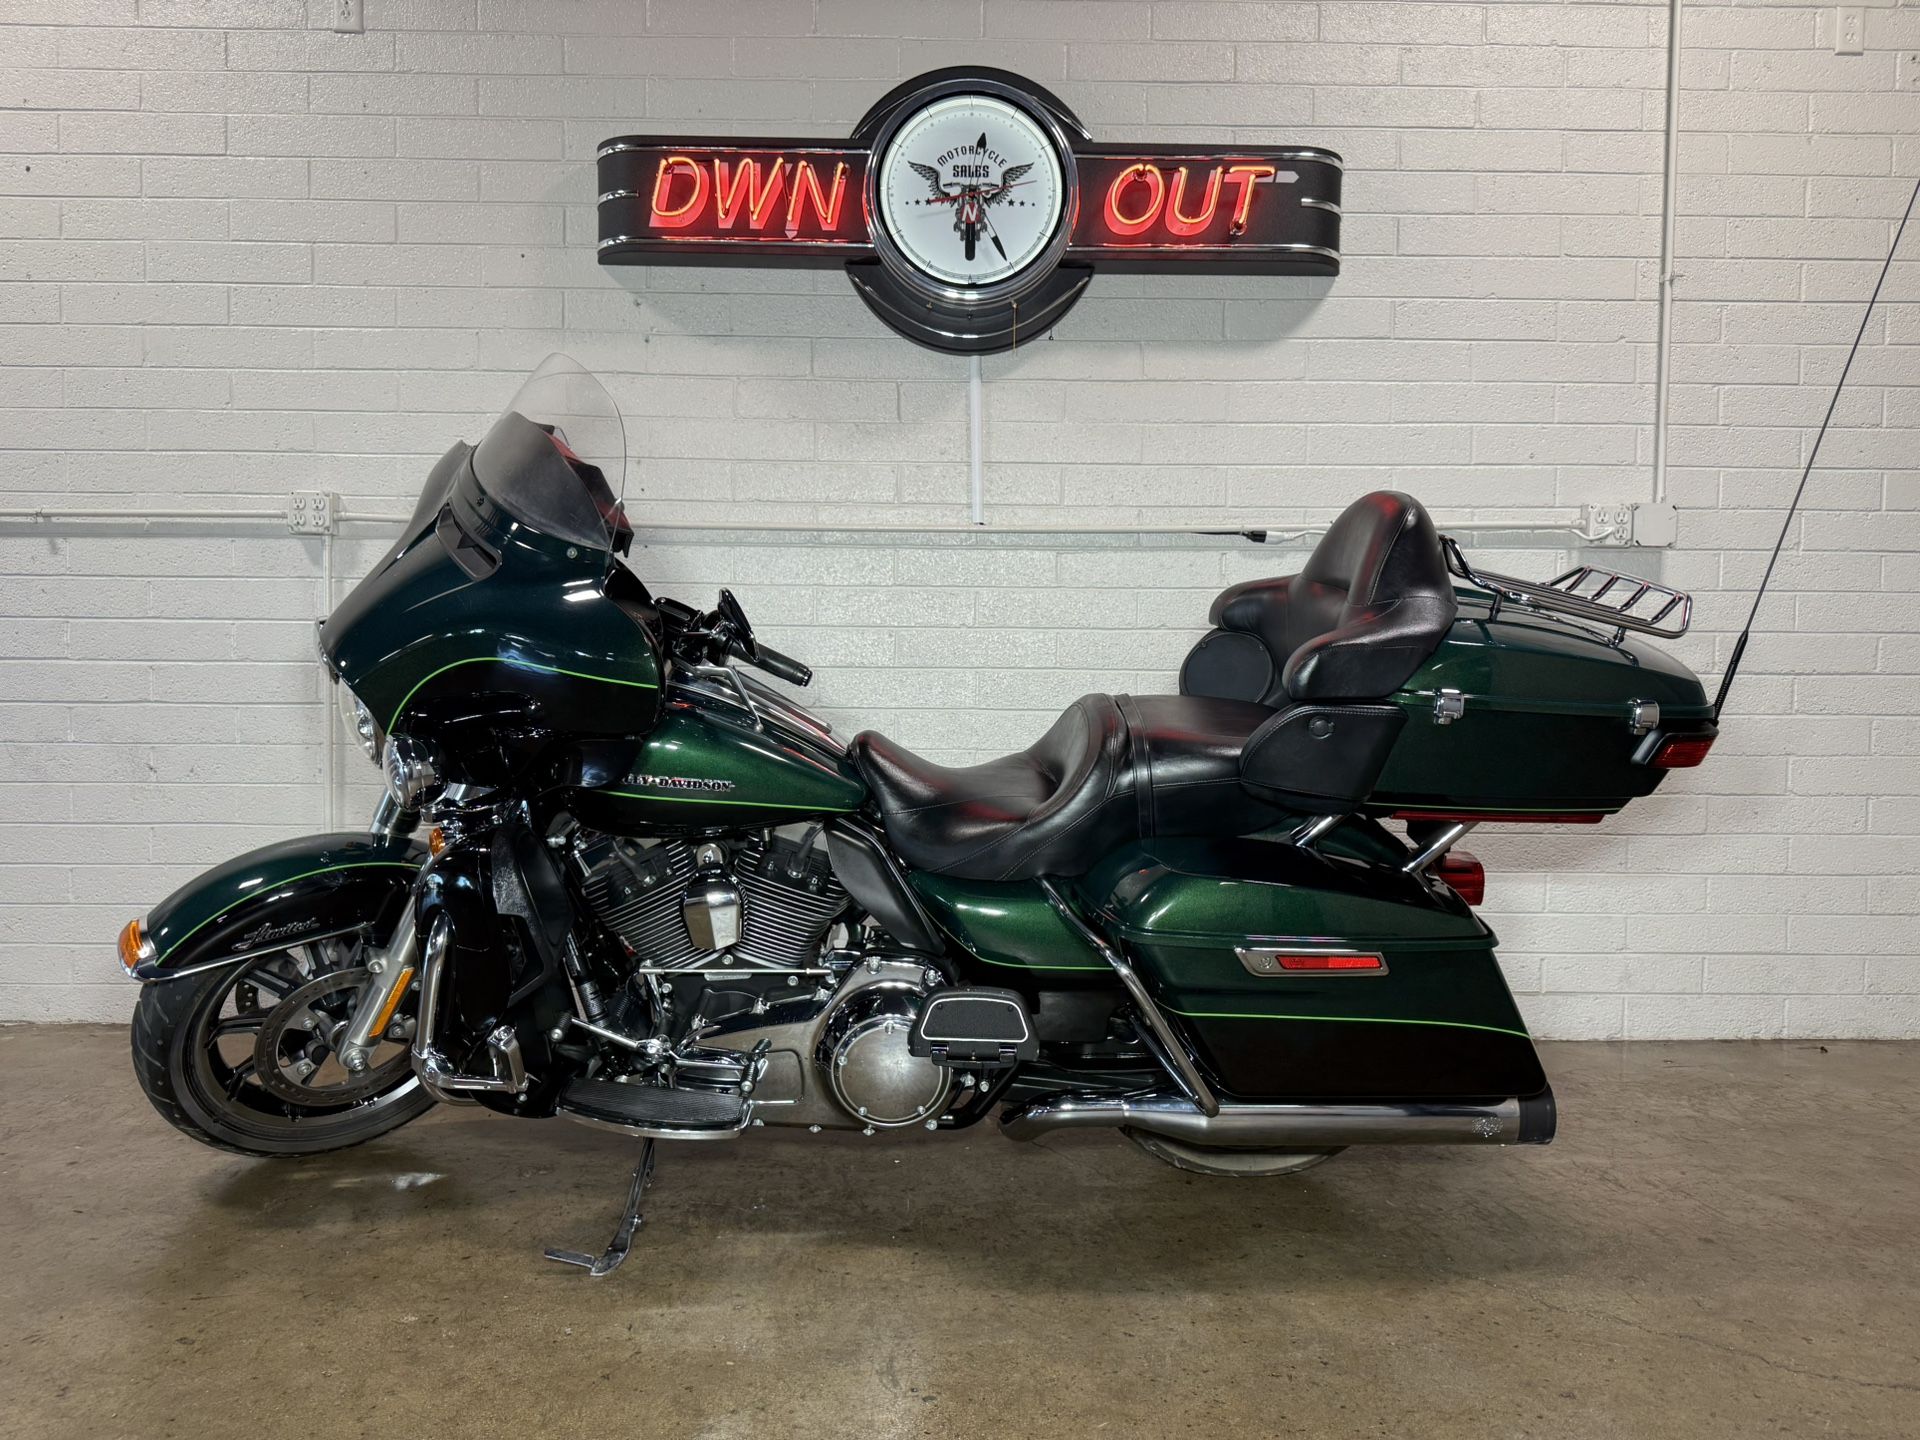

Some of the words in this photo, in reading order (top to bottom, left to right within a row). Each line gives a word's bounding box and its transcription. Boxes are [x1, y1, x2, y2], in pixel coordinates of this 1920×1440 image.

[937, 145, 1007, 168] MOTORCYCLE
[953, 164, 989, 178] SALES
[649, 157, 848, 231] DWN
[1104, 164, 1276, 236] OUT
[231, 917, 320, 951] Limited
